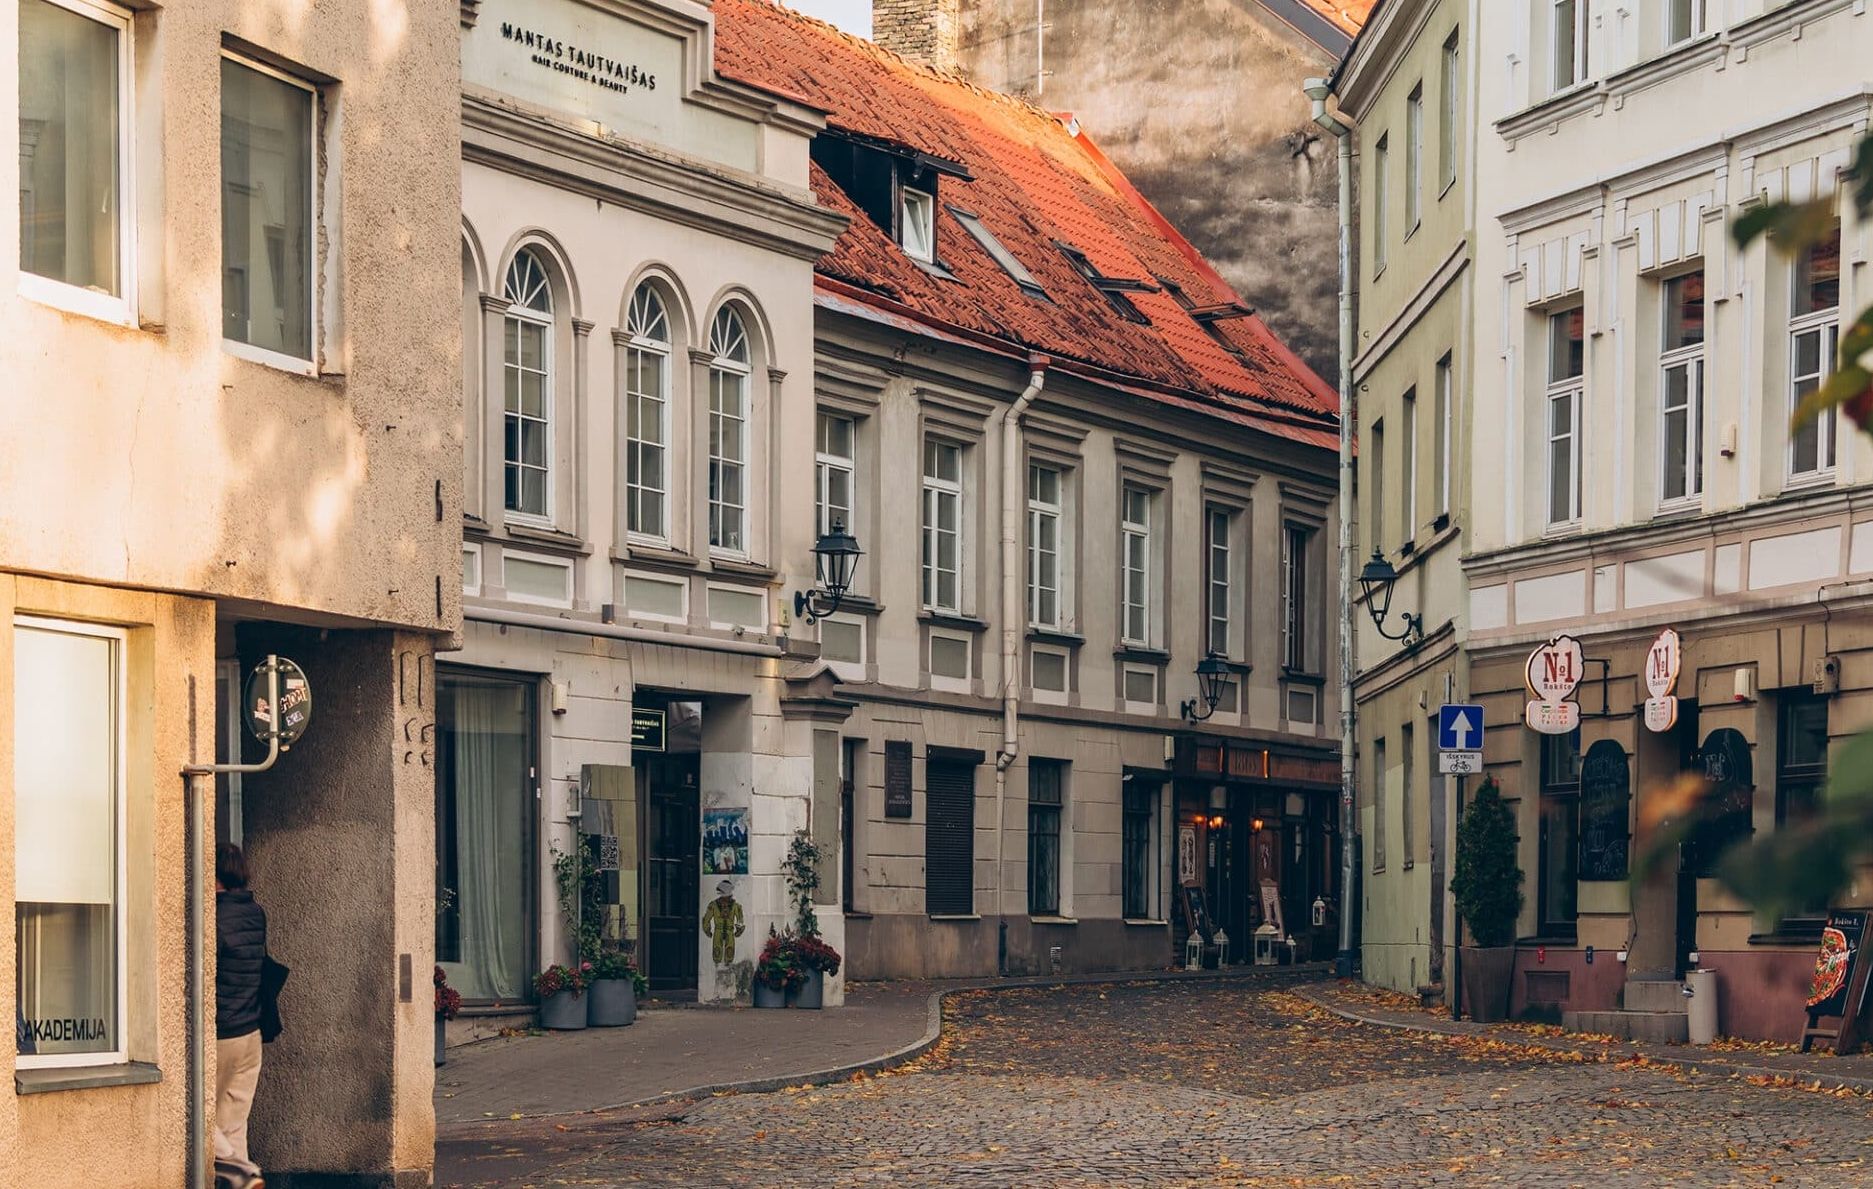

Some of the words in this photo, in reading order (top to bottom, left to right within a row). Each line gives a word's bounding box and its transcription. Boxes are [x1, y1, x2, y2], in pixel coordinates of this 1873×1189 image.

[501, 22, 563, 58] MANTAS
[568, 46, 656, 91] TAUTVAIŠAS
[531, 54, 551, 68] HAIR
[553, 61, 589, 81] COUTURE
[591, 74, 598, 84] &
[599, 77, 628, 95] BEAUTY
[24, 1018, 106, 1042] AKADEMIJA
